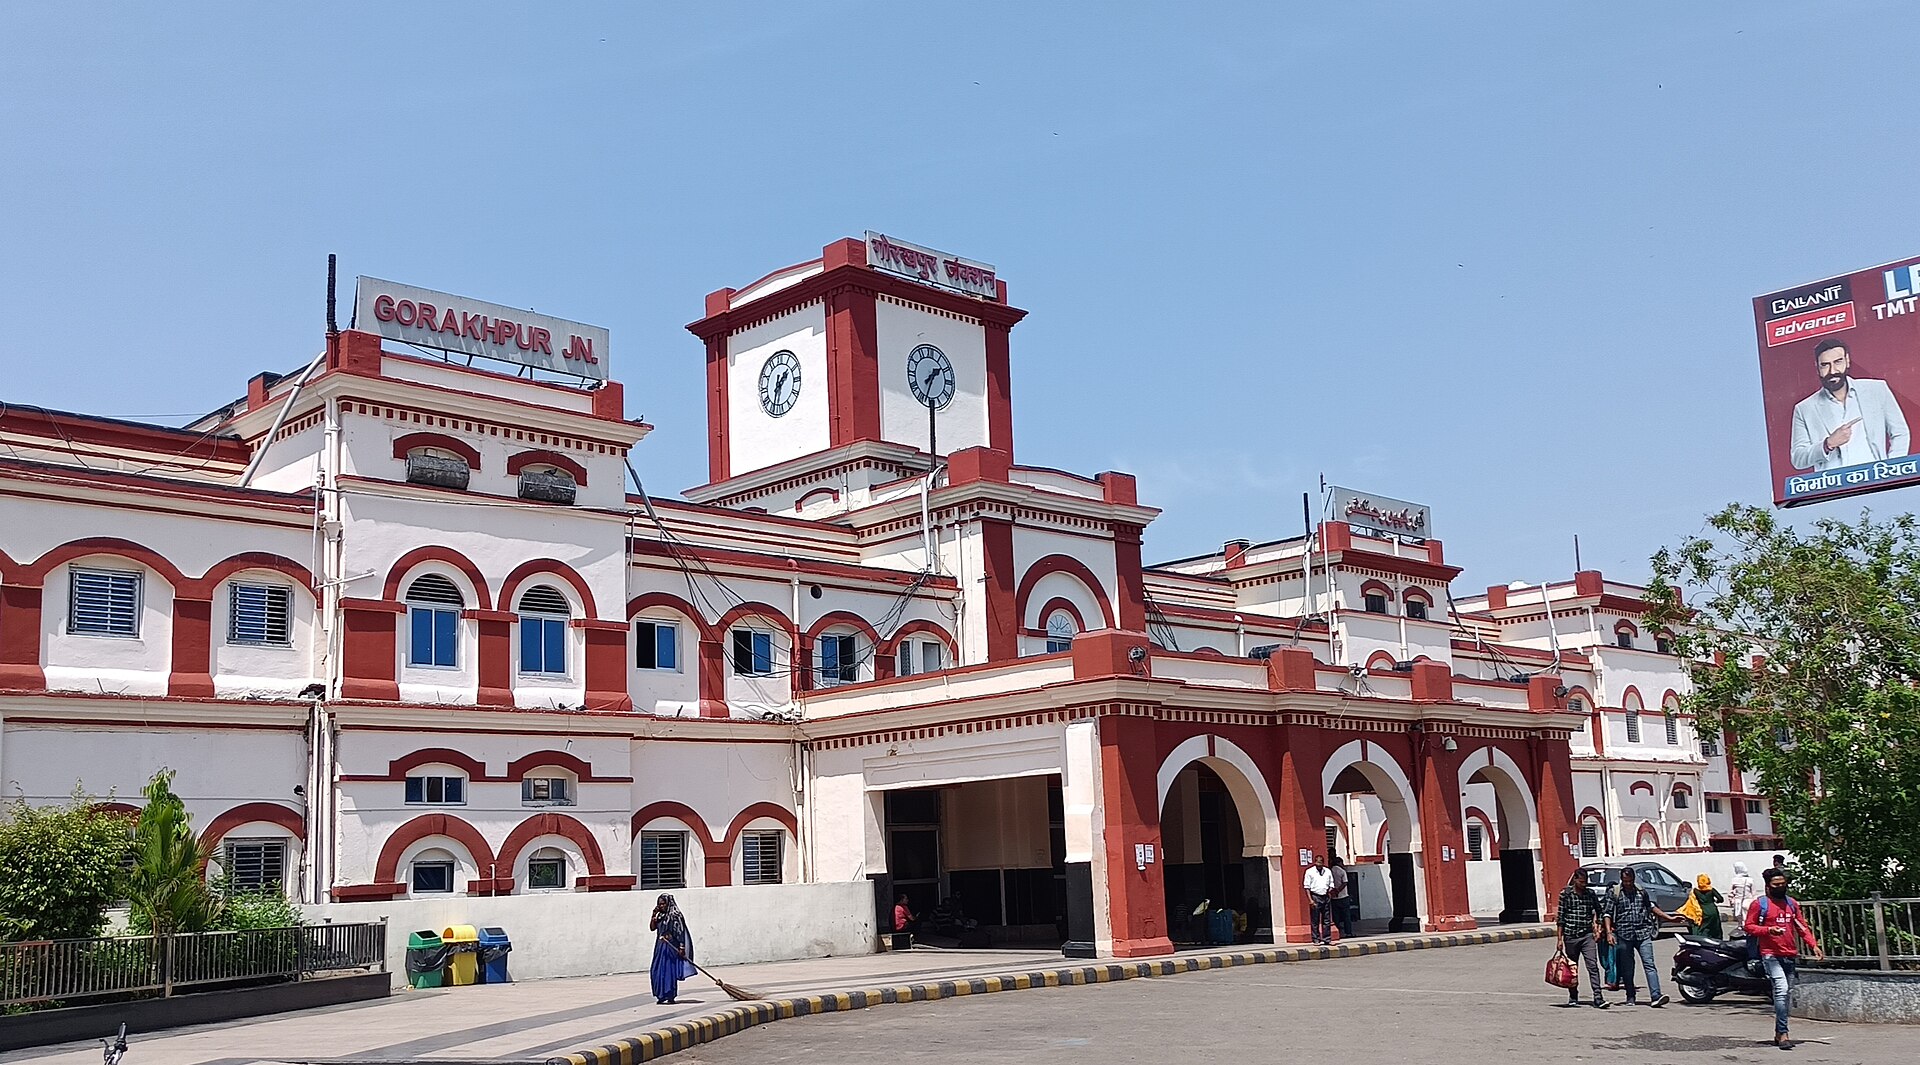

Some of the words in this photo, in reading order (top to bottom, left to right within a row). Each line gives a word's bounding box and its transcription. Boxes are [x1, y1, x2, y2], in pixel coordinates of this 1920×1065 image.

[871, 234, 937, 280] गोरखपुर
[1775, 312, 1846, 337] advance
[1871, 296, 1918, 320] TMT
[374, 294, 551, 354] GORAKHPUR
[562, 334, 598, 364] JN.
[1790, 472, 1842, 495] निर्माण
[1846, 469, 1870, 484] का
[1873, 461, 1917, 481] रियल
